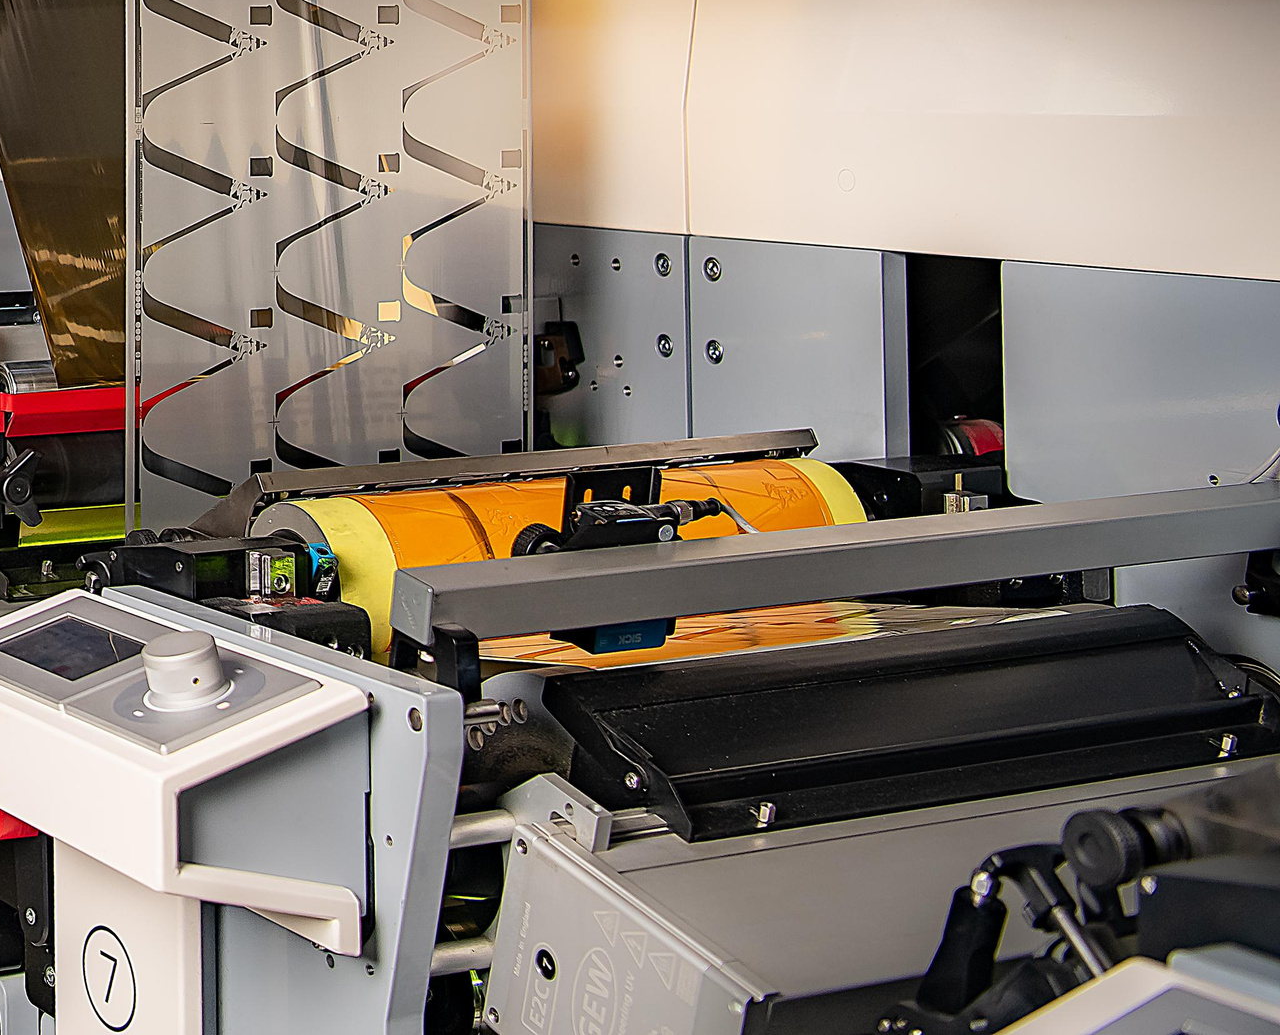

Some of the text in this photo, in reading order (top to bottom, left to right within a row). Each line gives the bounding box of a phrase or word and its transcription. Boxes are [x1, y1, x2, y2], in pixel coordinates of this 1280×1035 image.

[618, 633, 642, 645] SICK
[513, 953, 523, 977] Made
[520, 901, 531, 939] England
[99, 949, 117, 1004] 7
[529, 956, 553, 1030] E2C 7
[578, 954, 612, 1035] GEW
[624, 970, 635, 992] UV
